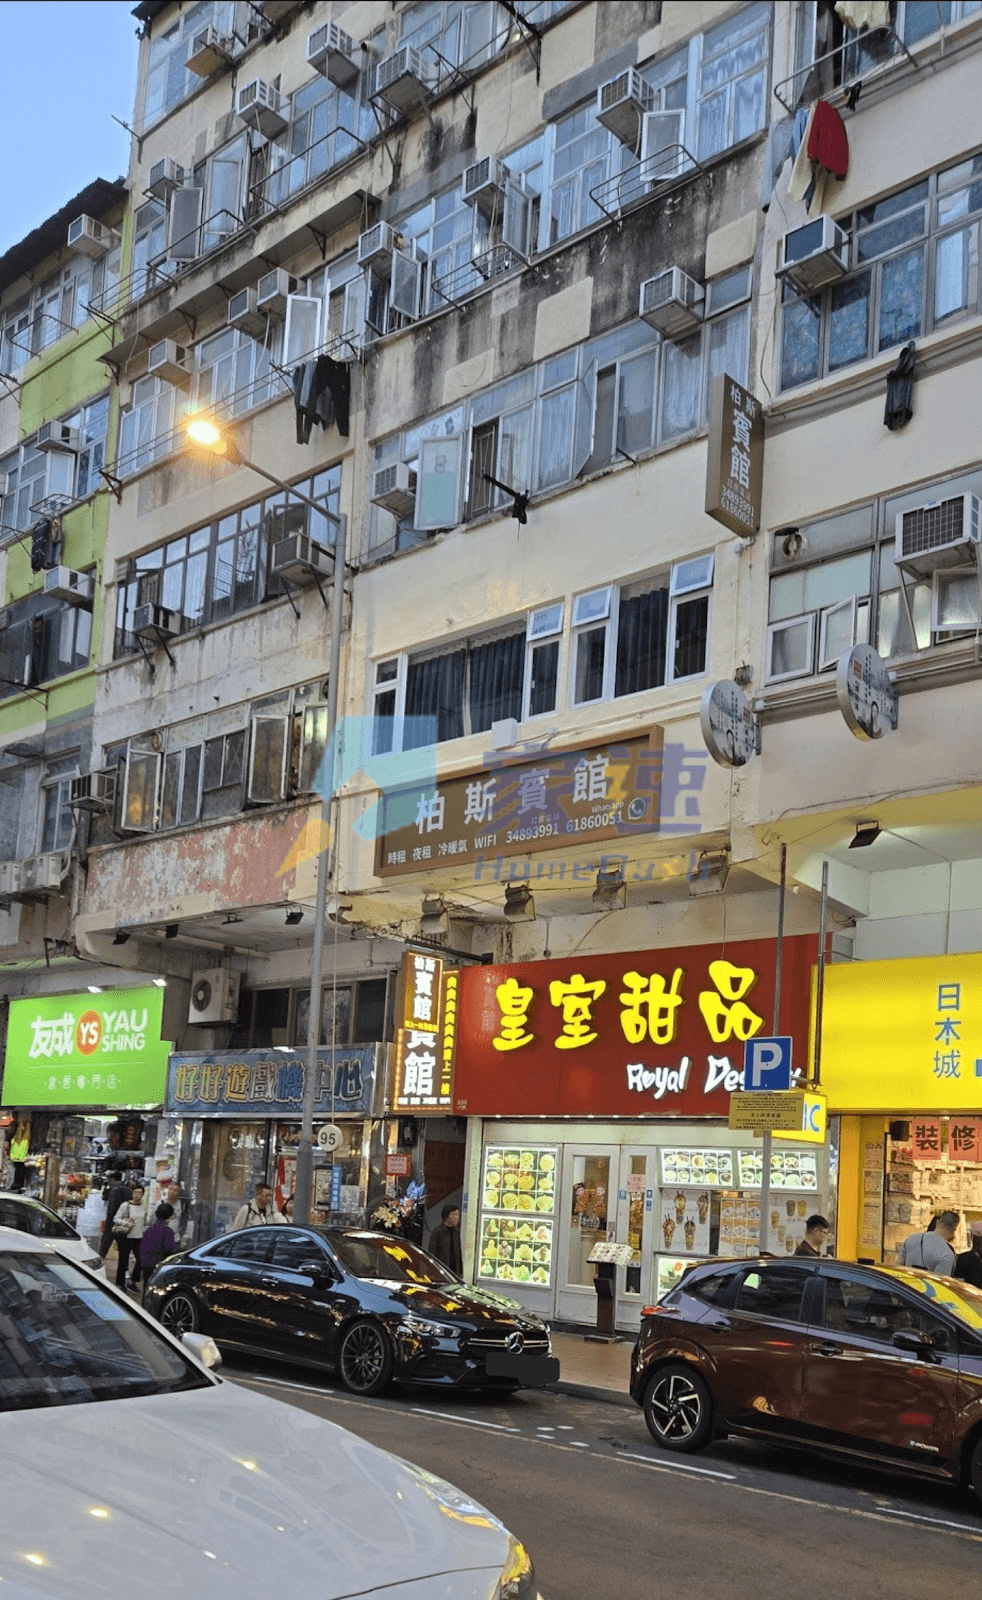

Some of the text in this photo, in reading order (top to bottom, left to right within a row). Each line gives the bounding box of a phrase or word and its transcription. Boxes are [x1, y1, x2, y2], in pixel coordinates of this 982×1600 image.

[730, 384, 756, 418] 柏斯
[730, 408, 752, 489] 賓館
[721, 497, 755, 529] 61860051
[415, 754, 609, 835] 柏斯賓館
[387, 850, 407, 865] 時租
[412, 845, 432, 861] 夜租
[474, 835, 497, 849] WIFI
[506, 822, 560, 843] 34893991
[566, 810, 624, 833] 61860051
[102, 1008, 148, 1033] YAU
[492, 960, 764, 1051] 皇室甜品
[79, 1021, 99, 1045] YS
[101, 1032, 146, 1052] SHING
[933, 983, 962, 1079] 日本城
[175, 1059, 364, 1102] 好好遊戲機中心
[626, 1057, 690, 1099] Royal
[752, 1042, 783, 1087] P
[320, 1131, 336, 1146] 95
[915, 1125, 976, 1151] 裝修
